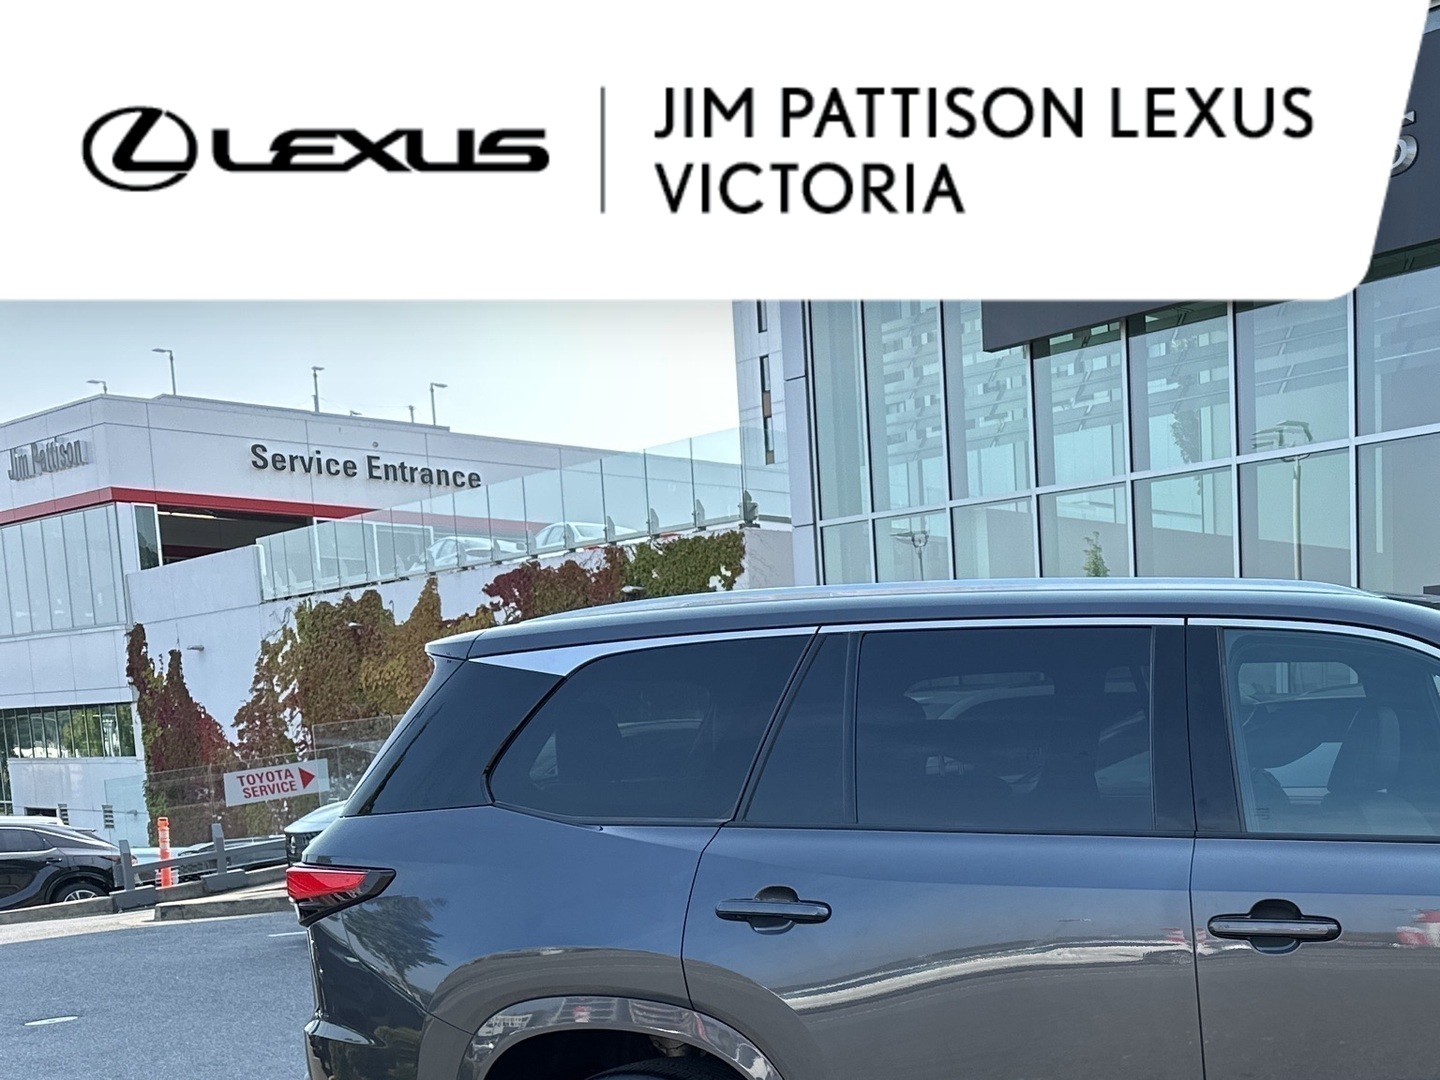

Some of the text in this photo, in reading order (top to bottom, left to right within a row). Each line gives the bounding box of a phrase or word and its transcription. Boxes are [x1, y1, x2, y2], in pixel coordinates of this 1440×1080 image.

[8, 439, 84, 481] Jim Pattison
[250, 443, 482, 488] Service Entrance
[236, 768, 295, 787] TOYOTA
[242, 780, 298, 799] SERVICE
